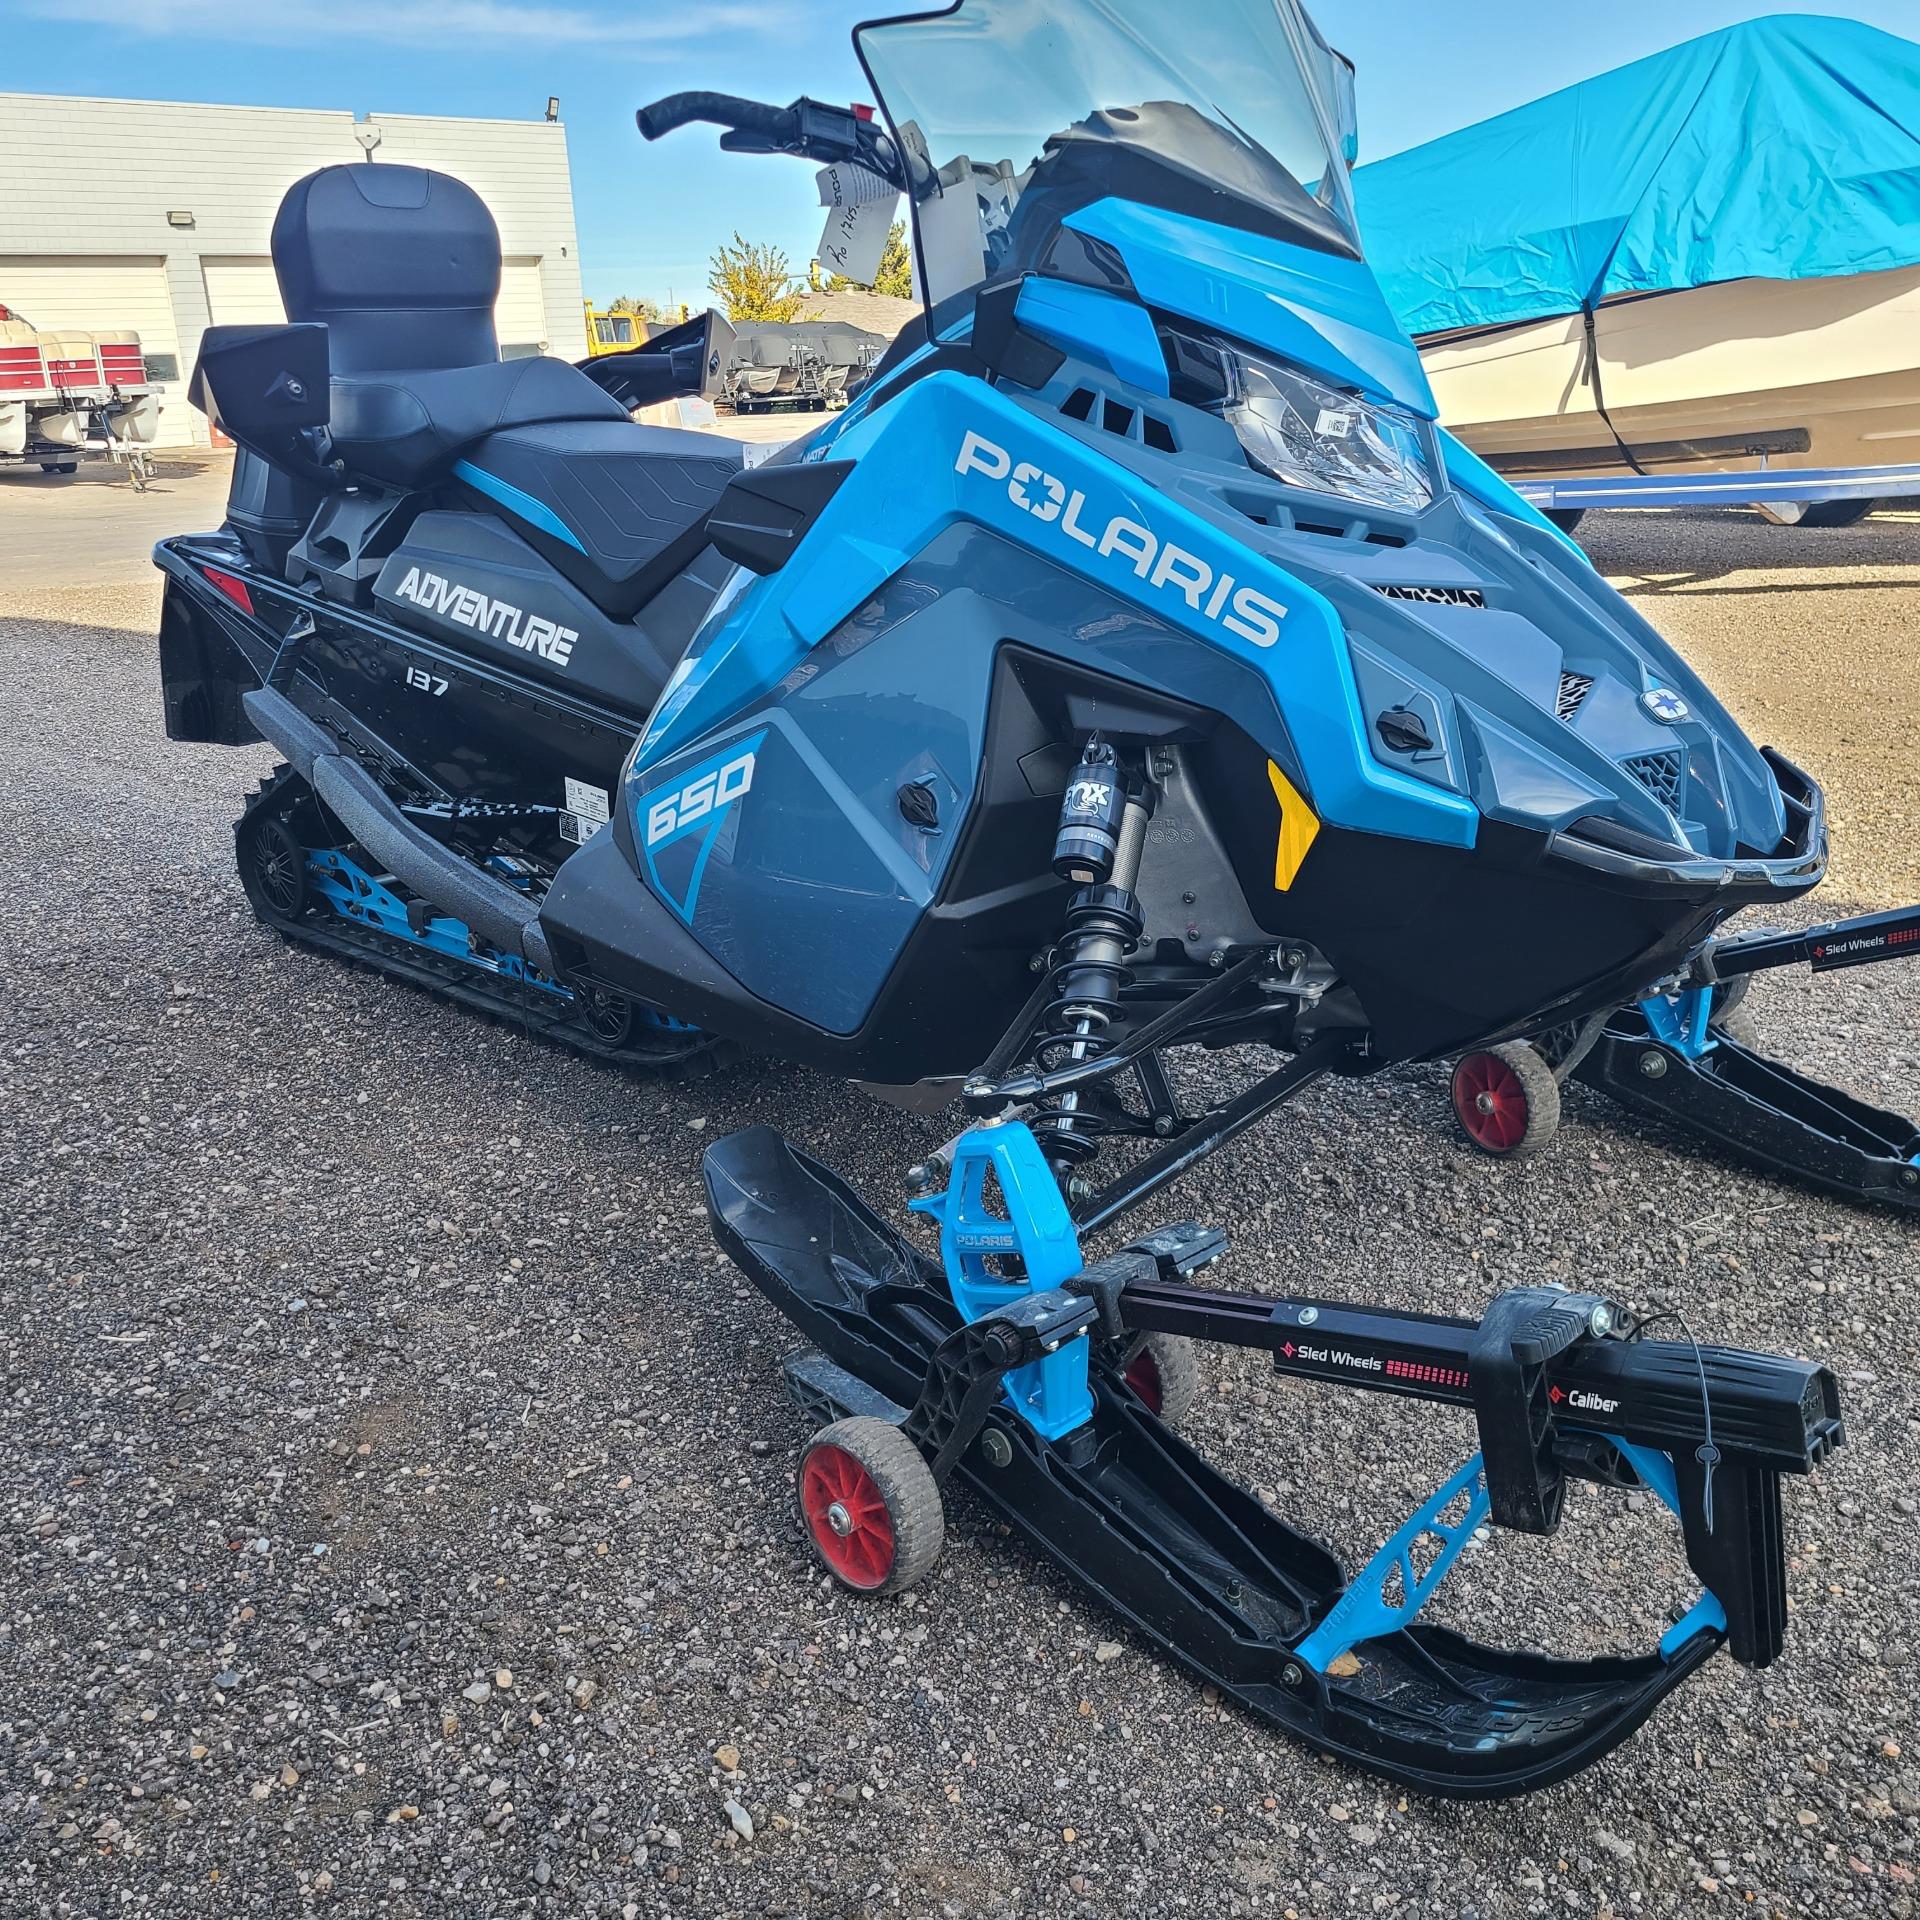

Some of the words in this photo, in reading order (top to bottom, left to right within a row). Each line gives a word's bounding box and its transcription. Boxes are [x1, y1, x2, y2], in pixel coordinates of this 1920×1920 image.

[954, 430, 1289, 648] POLARIS
[395, 566, 579, 668] ADVENTURE
[406, 666, 449, 697] 137
[647, 751, 755, 847] 650
[1825, 942, 1847, 956] Sled
[1848, 935, 1885, 952] Wheels
[956, 1234, 1014, 1247] POLARIS
[1297, 1345, 1328, 1363] Sled
[1331, 1350, 1383, 1371] Wheels
[1568, 1390, 1619, 1413] Caliber
